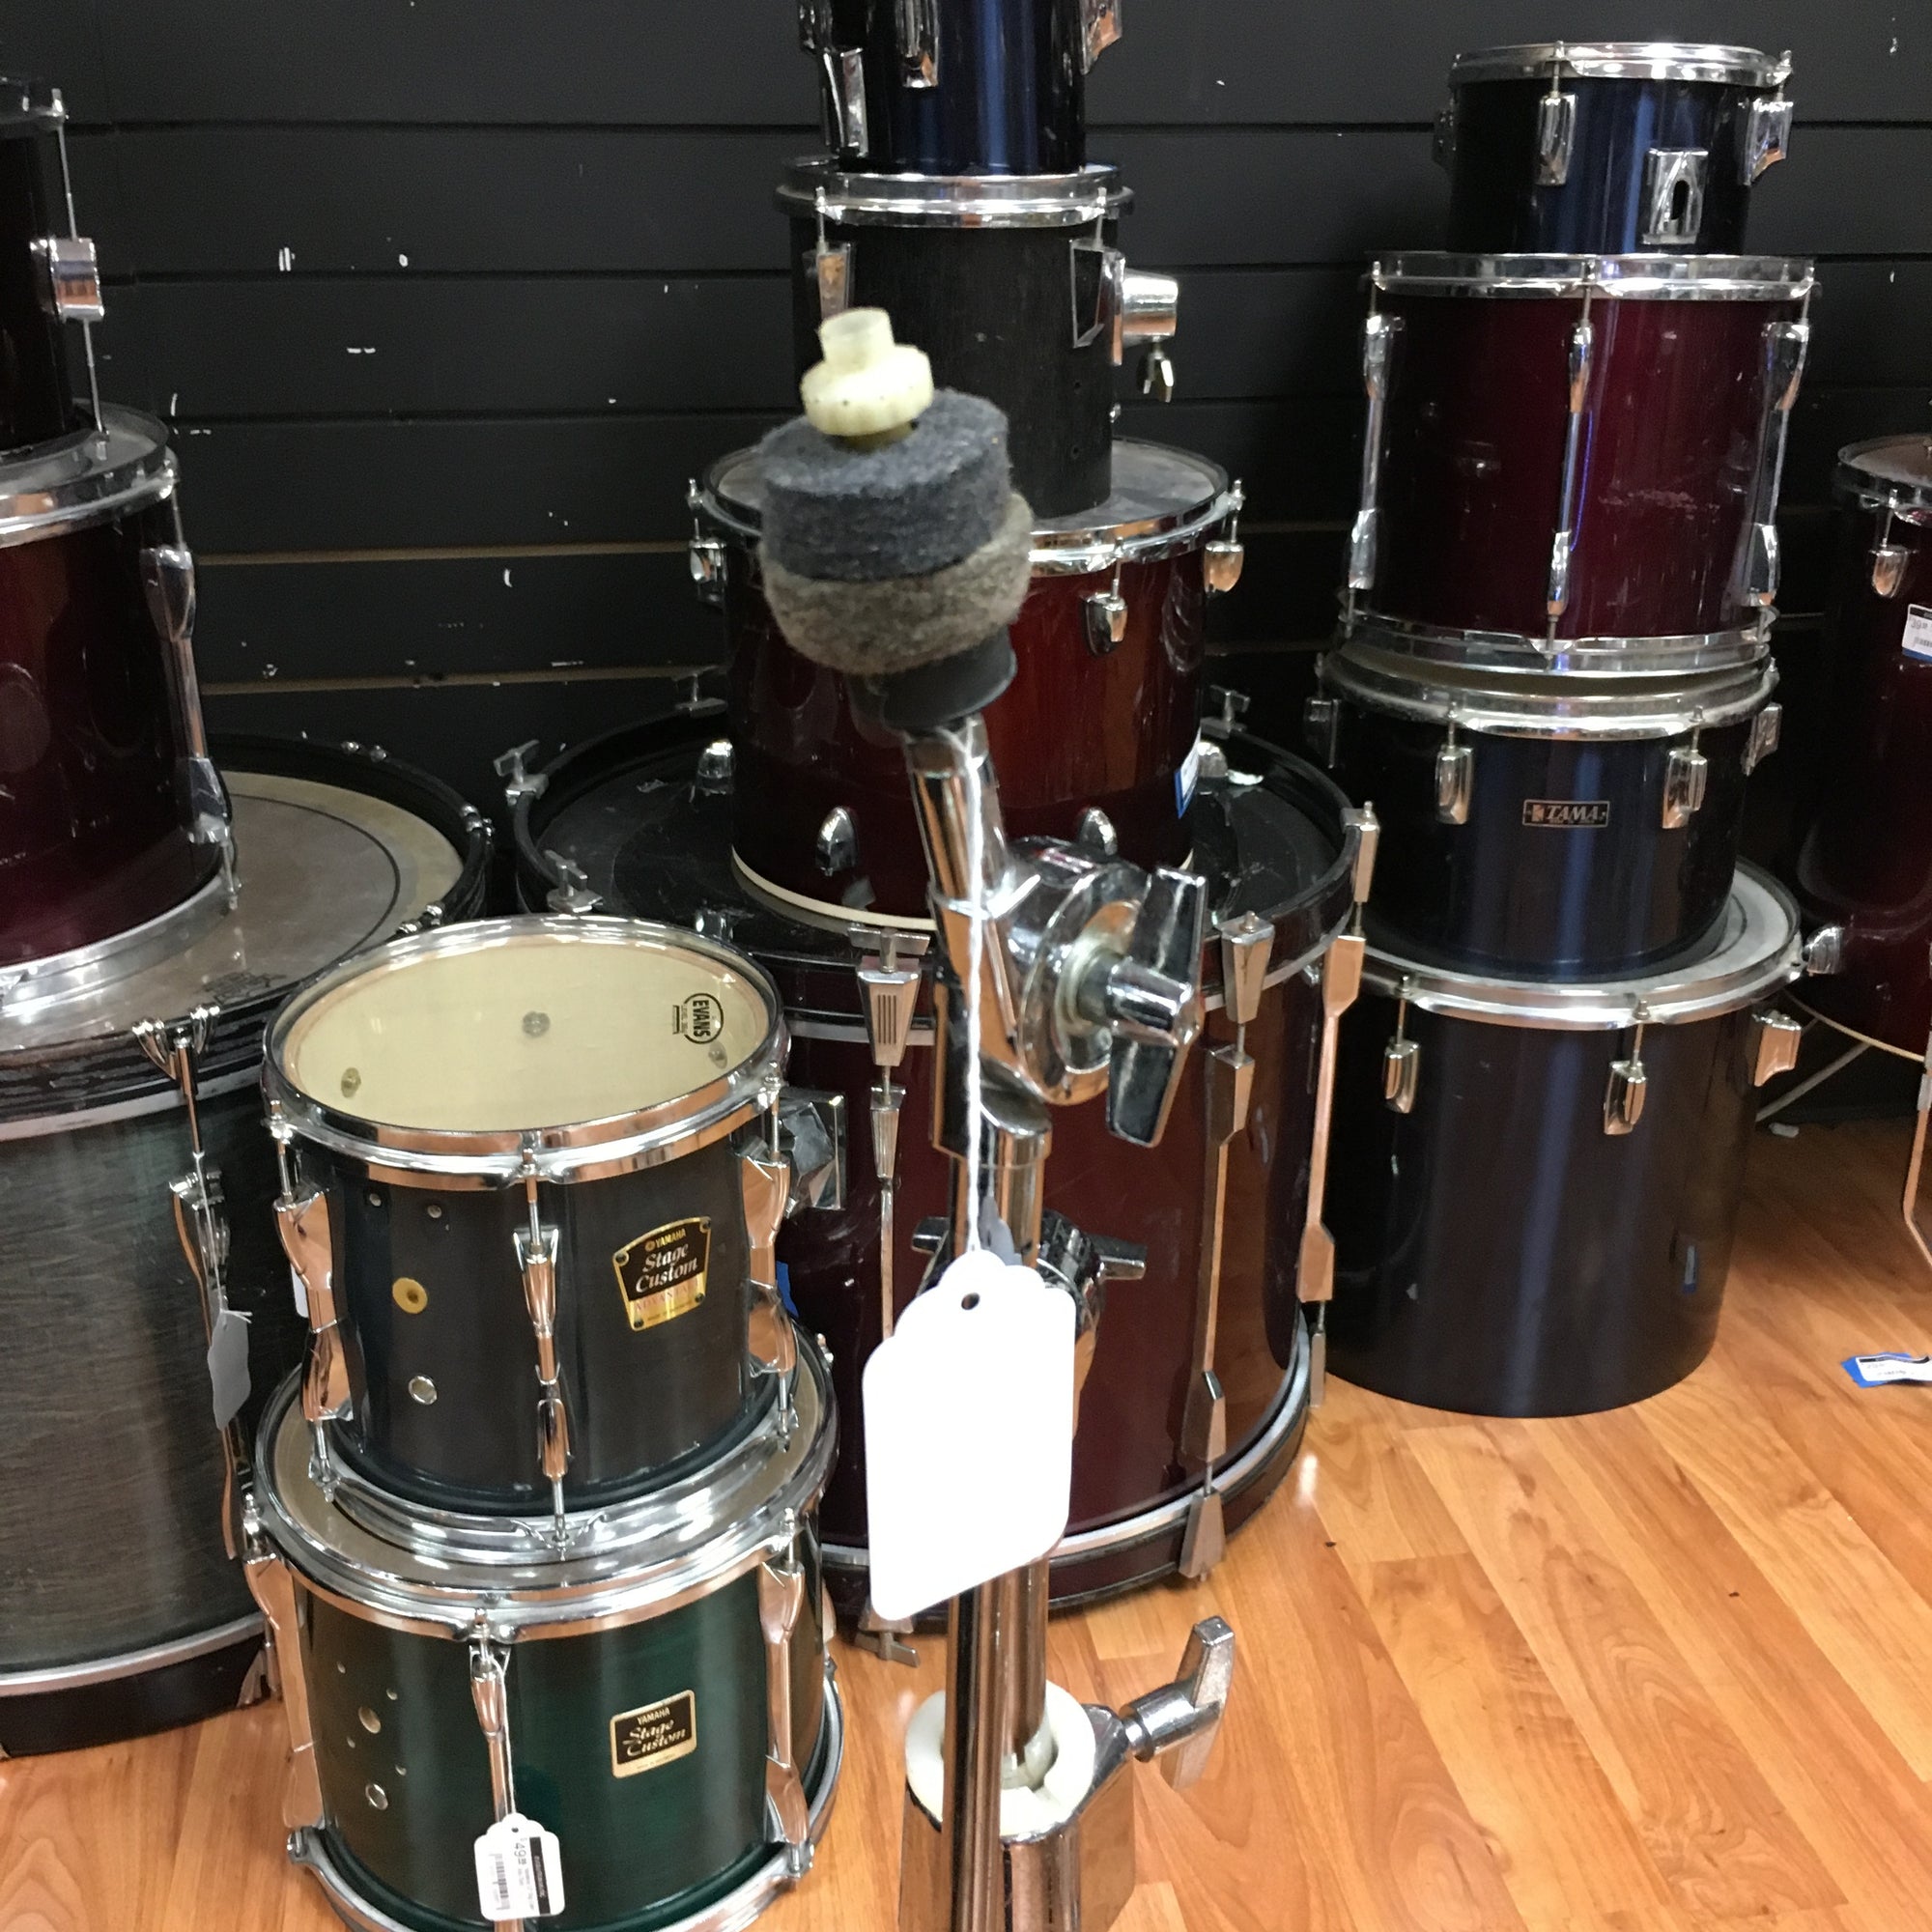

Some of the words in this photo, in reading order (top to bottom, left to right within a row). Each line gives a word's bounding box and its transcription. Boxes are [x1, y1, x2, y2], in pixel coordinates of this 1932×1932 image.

[1547, 805, 1599, 820] TAMA
[693, 1000, 711, 1037] EVANS
[656, 1228, 687, 1248] YAMAHA
[642, 1243, 689, 1272] Stage
[636, 1258, 697, 1293] Custom
[638, 1707, 670, 1725] YAMAHA
[622, 1719, 674, 1745] Stage
[627, 1729, 686, 1756] Custom
